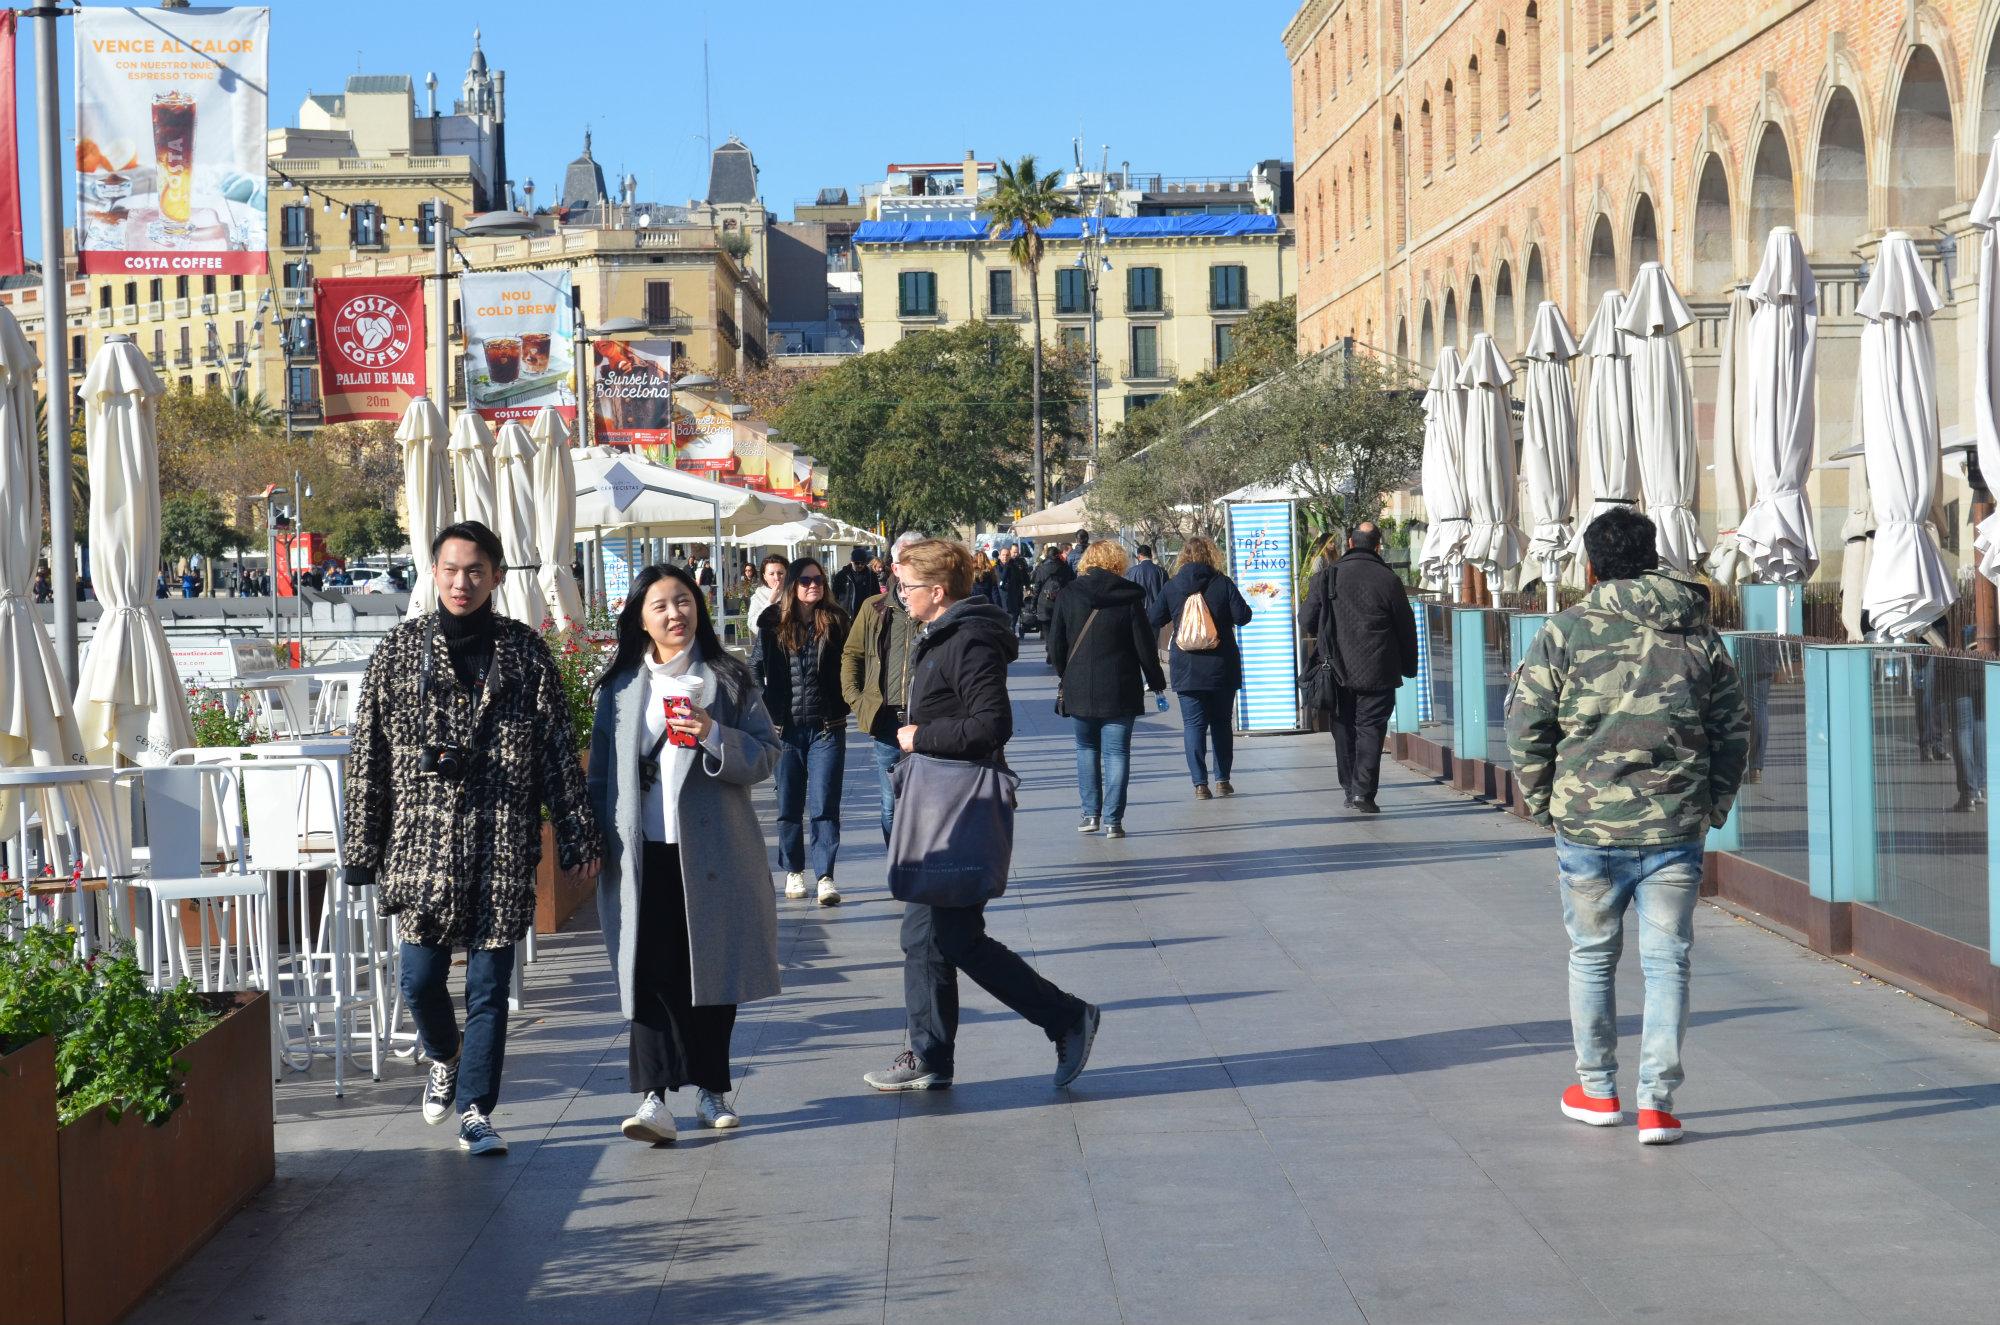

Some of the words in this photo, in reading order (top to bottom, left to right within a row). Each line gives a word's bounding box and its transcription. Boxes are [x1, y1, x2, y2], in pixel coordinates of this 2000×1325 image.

[93, 39, 154, 53] VENCE
[161, 39, 184, 53] AL
[191, 39, 255, 54] CALOR
[116, 61, 137, 69] CON
[141, 61, 188, 69] NUESTRO
[128, 72, 179, 80] ESPRESSO
[184, 72, 215, 80] TONIC
[124, 257, 169, 269] COSTA
[172, 257, 222, 269] COFFEE
[501, 291, 532, 301] NOU
[344, 297, 397, 320] COSTA
[477, 306, 513, 317] COLD
[517, 303, 557, 315] BREW
[396, 324, 407, 332] 1971
[343, 339, 407, 365] COFFEE
[336, 372, 371, 385] PALAU
[374, 372, 389, 384] DE
[392, 372, 415, 385] MAR
[604, 370, 648, 385] Sunset
[649, 374, 660, 385] in
[596, 383, 670, 398] Barcelona
[366, 395, 390, 407] 20m
[494, 411, 520, 419] COSTA
[677, 425, 732, 437] Barcelona
[1237, 538, 1279, 550] TAPES
[1244, 558, 1287, 570] PINXO
